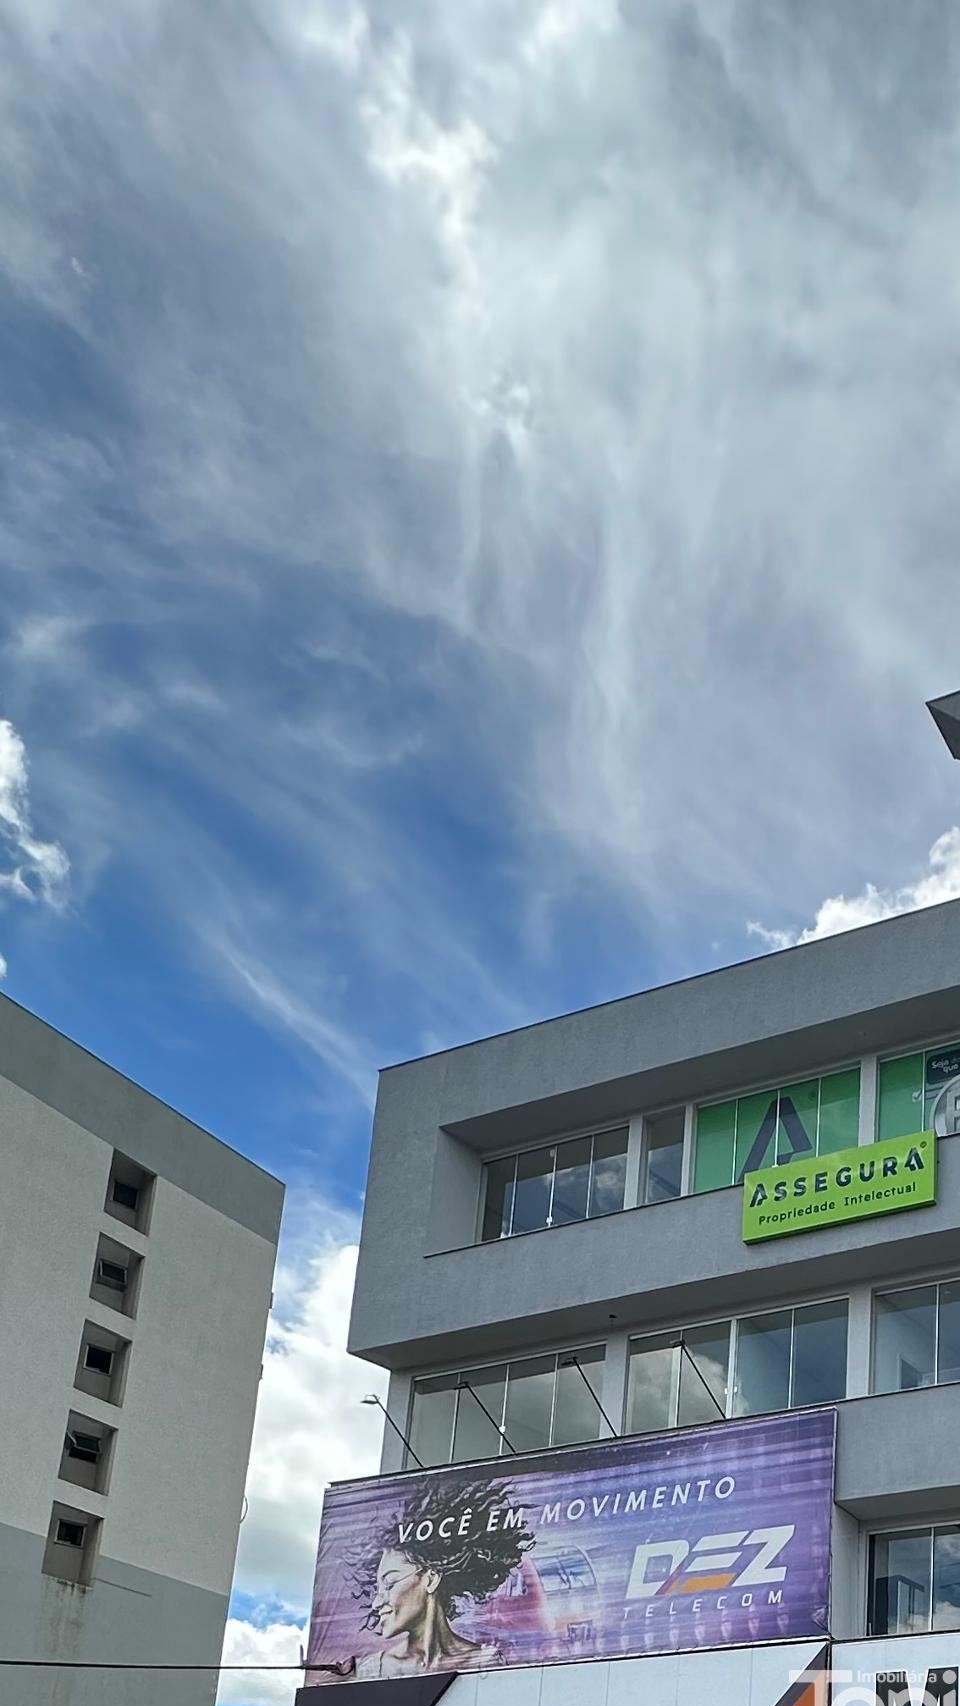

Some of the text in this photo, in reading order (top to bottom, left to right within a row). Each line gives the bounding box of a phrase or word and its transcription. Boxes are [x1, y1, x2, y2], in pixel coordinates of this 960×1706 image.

[750, 1147, 925, 1207] ASSEGURA
[758, 1182, 917, 1225] Propriedade Intelectual
[397, 1476, 736, 1544] VOCÊ EM MOVIMENTO
[625, 1525, 796, 1600] DEZ
[622, 1590, 783, 1620] TELECOM
